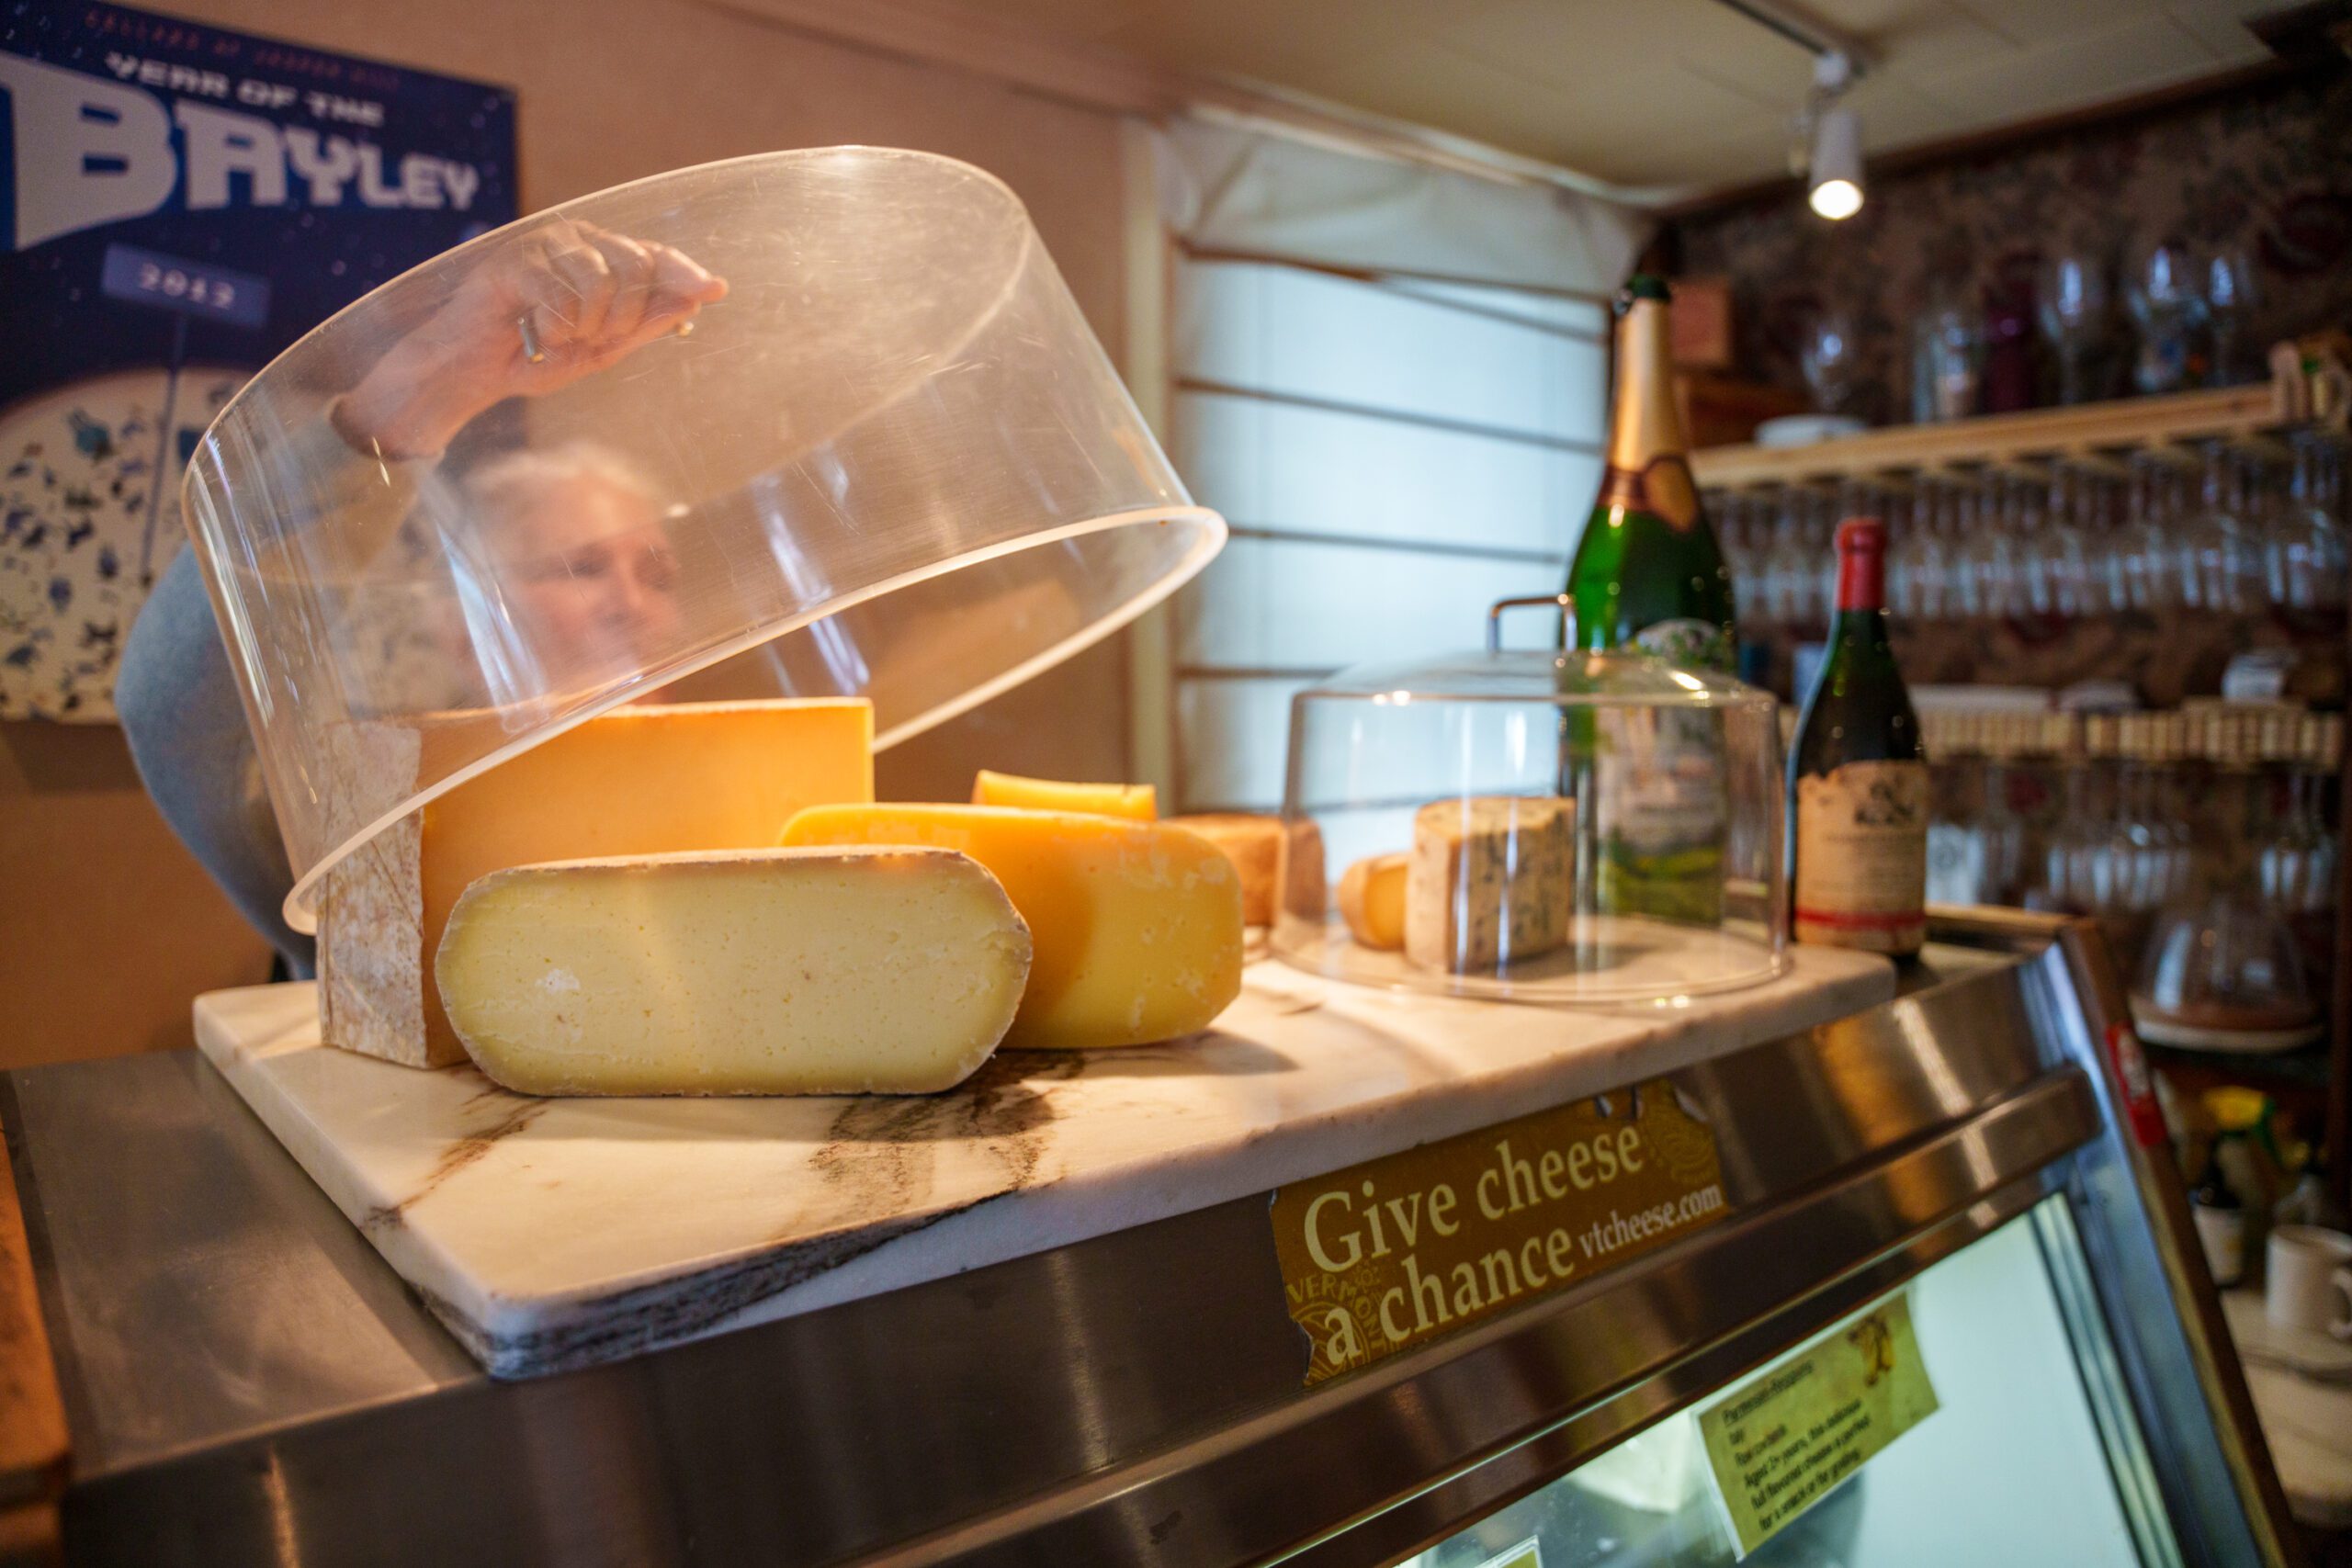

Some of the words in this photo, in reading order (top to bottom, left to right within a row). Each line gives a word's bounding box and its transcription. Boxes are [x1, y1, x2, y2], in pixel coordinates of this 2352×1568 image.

[0, 49, 480, 253] BAYLEY
[105, 51, 229, 98] YEAR
[236, 80, 299, 108] OF
[304, 92, 384, 127] THE
[1303, 1179, 1460, 1272] Give
[1476, 1124, 1643, 1219] cheese
[1324, 1307, 1361, 1365] a
[1380, 1227, 1574, 1342] chance
[1578, 1183, 1723, 1258] vtcheese.com
